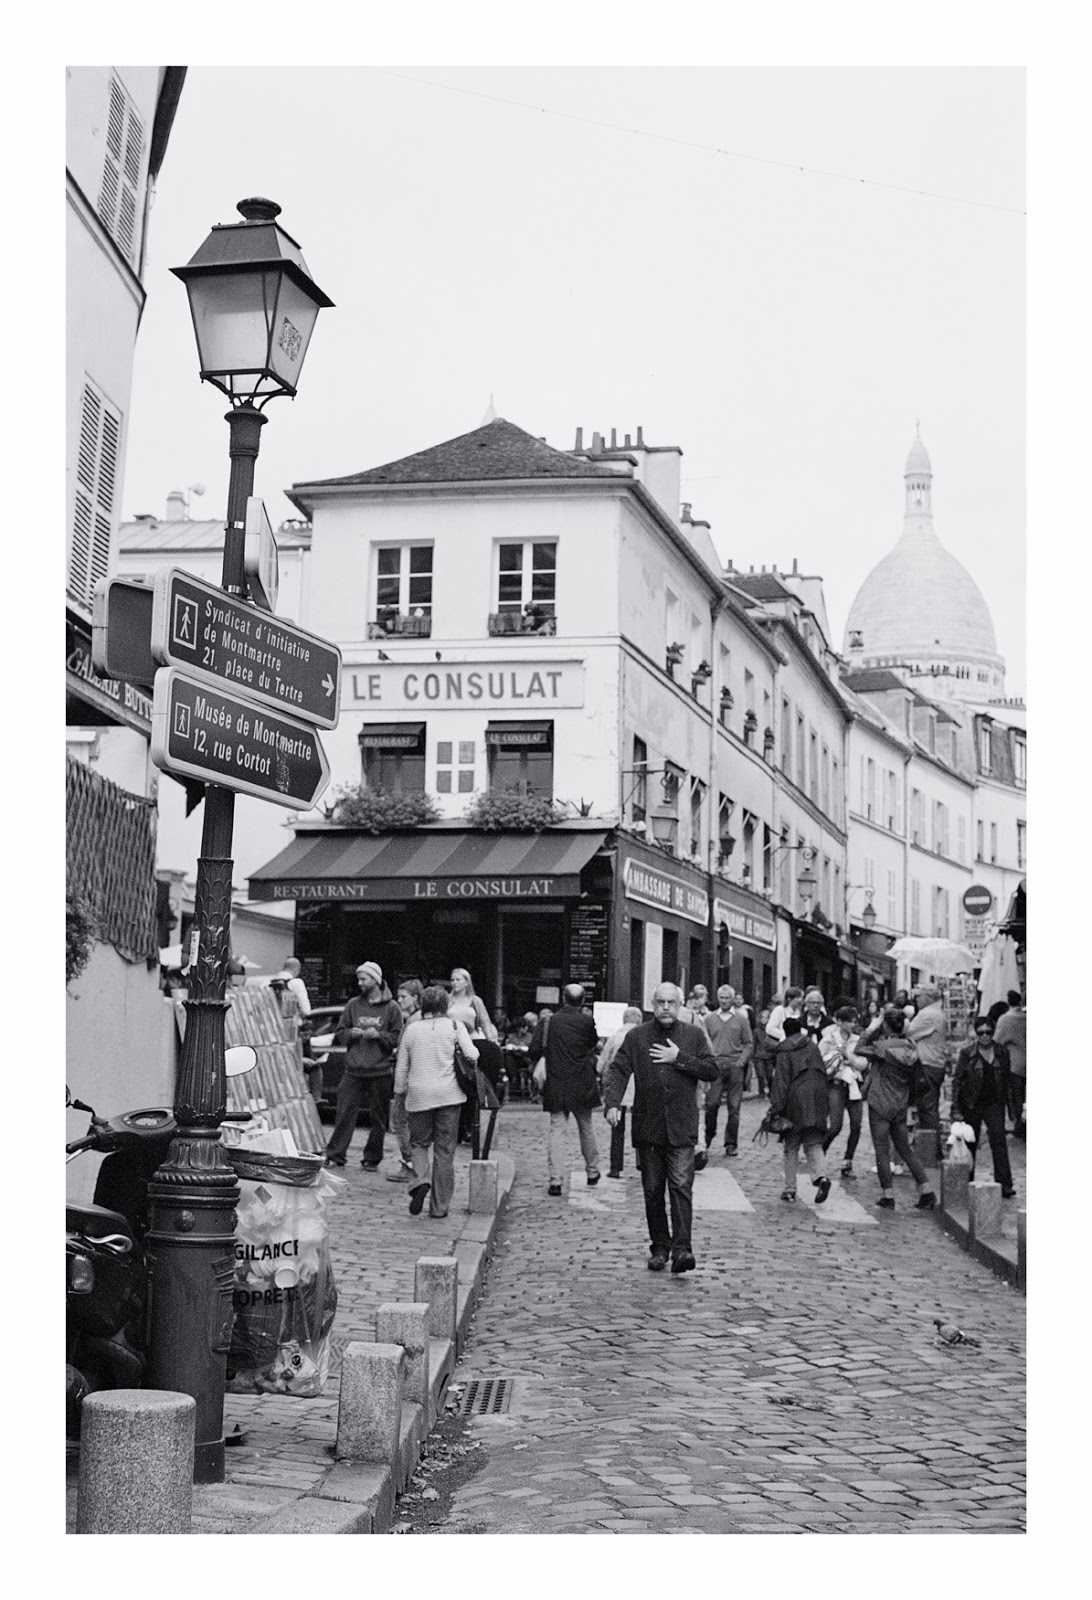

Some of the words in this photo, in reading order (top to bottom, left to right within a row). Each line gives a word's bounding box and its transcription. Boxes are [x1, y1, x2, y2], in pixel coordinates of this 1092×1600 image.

[203, 624, 217, 643] de
[221, 630, 282, 671] Montmartre
[205, 599, 251, 635] Syndicat
[255, 624, 310, 662] d'initiative
[225, 658, 253, 683] place
[258, 671, 271, 690] du
[275, 677, 303, 703] Tertre
[352, 674, 382, 700] LE
[403, 671, 563, 701] CONSULAT
[194, 696, 232, 730] Musée
[236, 714, 250, 736] de
[253, 719, 312, 760] Montmartre
[193, 728, 209, 757] 12,
[213, 741, 232, 761] rue
[236, 744, 271, 775] Cortot
[273, 885, 368, 898] RESTAURANT
[414, 882, 438, 897] LE
[446, 879, 553, 897] CONSULAT
[627, 868, 671, 903] AMBASSADE
